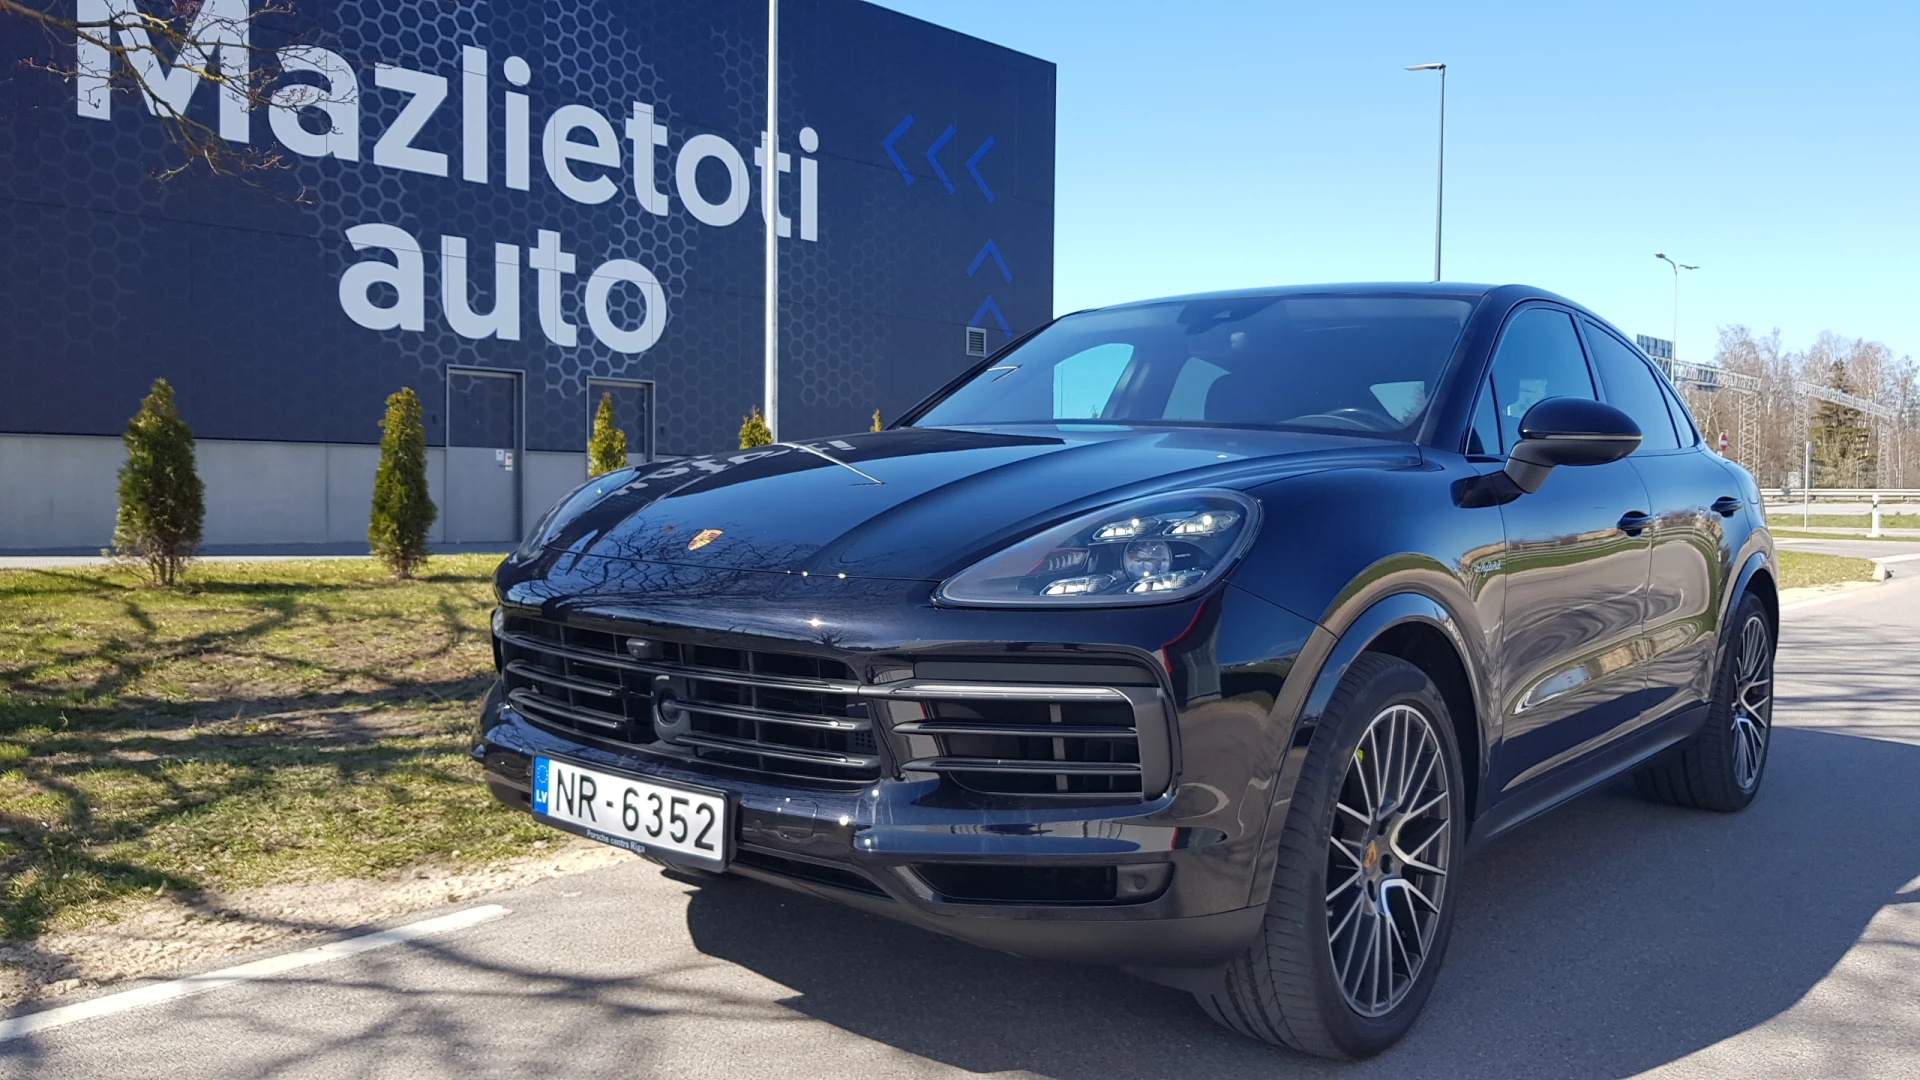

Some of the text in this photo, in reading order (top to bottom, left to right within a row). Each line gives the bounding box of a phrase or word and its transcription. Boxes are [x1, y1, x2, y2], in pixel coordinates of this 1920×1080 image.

[77, 0, 819, 242] Mazlietoti
[339, 223, 668, 354] auto
[536, 789, 548, 803] LV
[556, 768, 715, 852] NR-6352
[587, 829, 609, 843] Porsche
